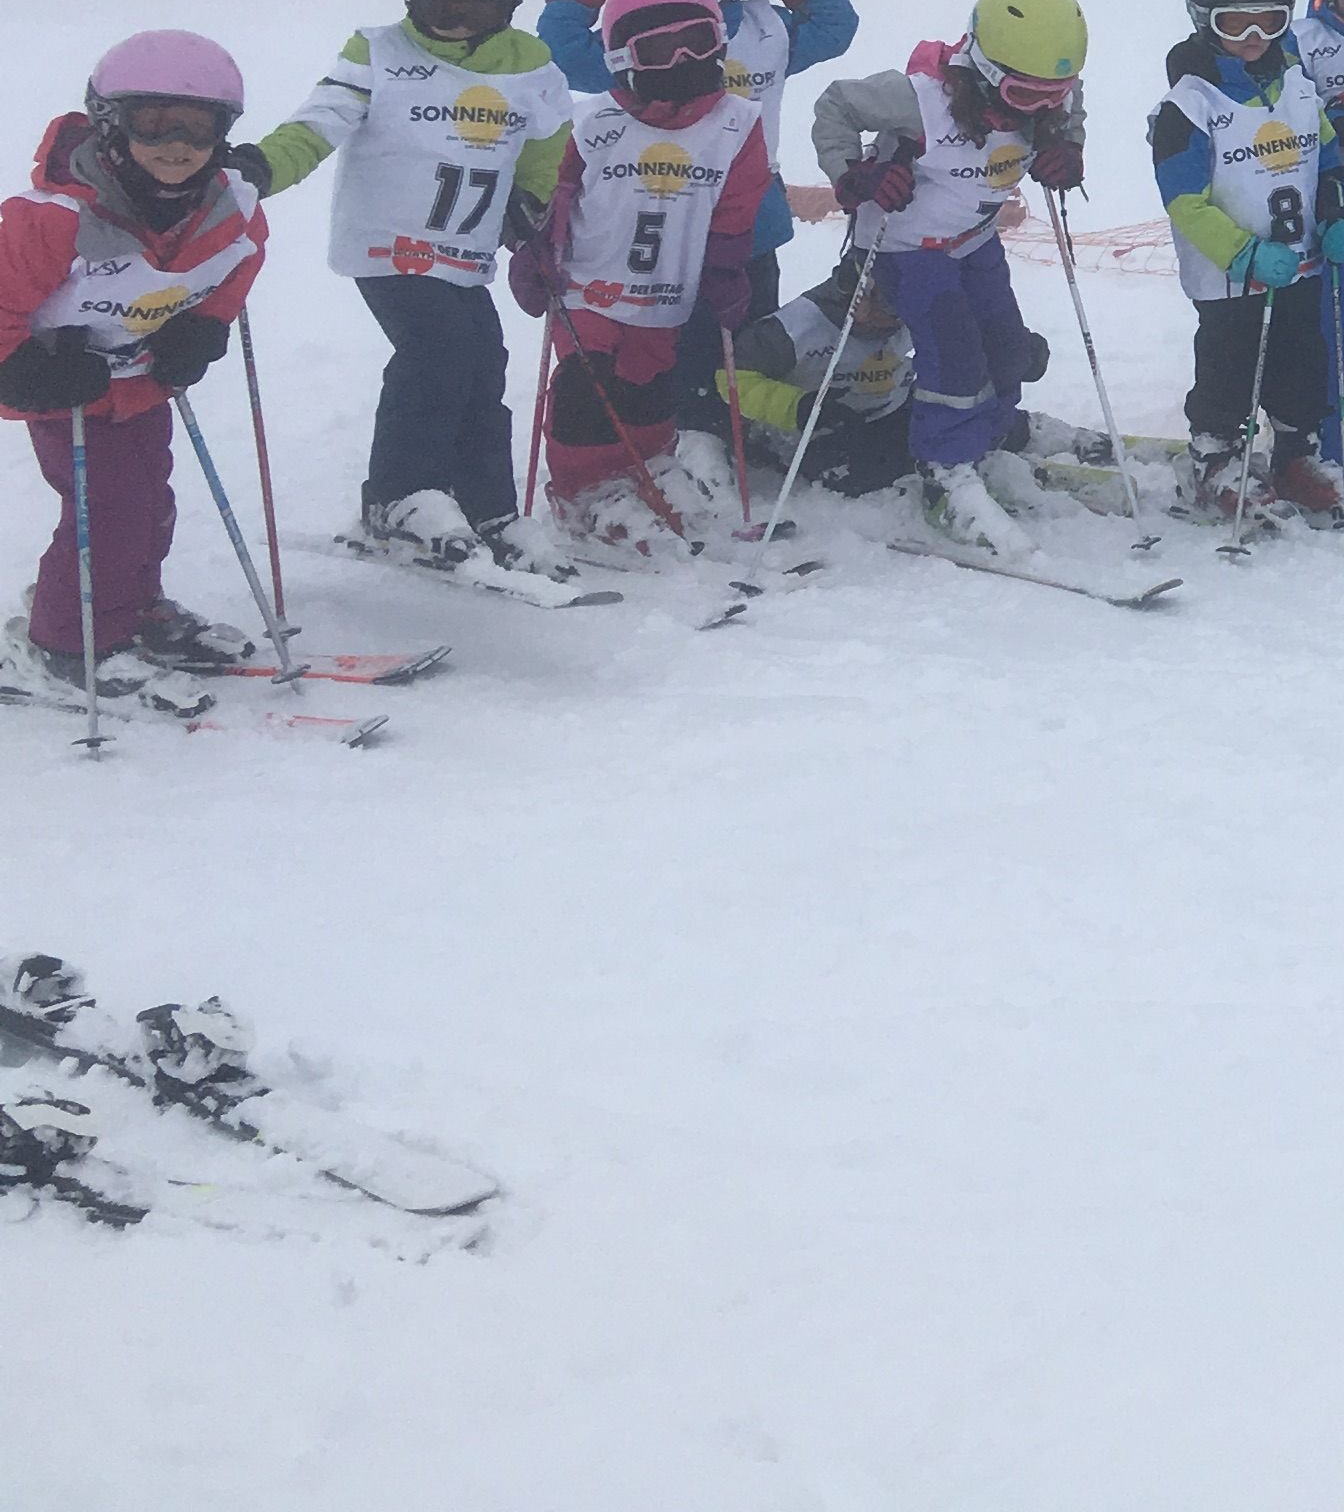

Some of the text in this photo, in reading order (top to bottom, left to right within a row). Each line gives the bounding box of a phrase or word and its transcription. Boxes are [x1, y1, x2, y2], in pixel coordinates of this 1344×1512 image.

[602, 161, 724, 183] SONNENKOPF
[1222, 132, 1319, 165] SONNENKOPF
[425, 162, 500, 235] 17
[1267, 185, 1304, 245] 8
[626, 210, 667, 274] 5
